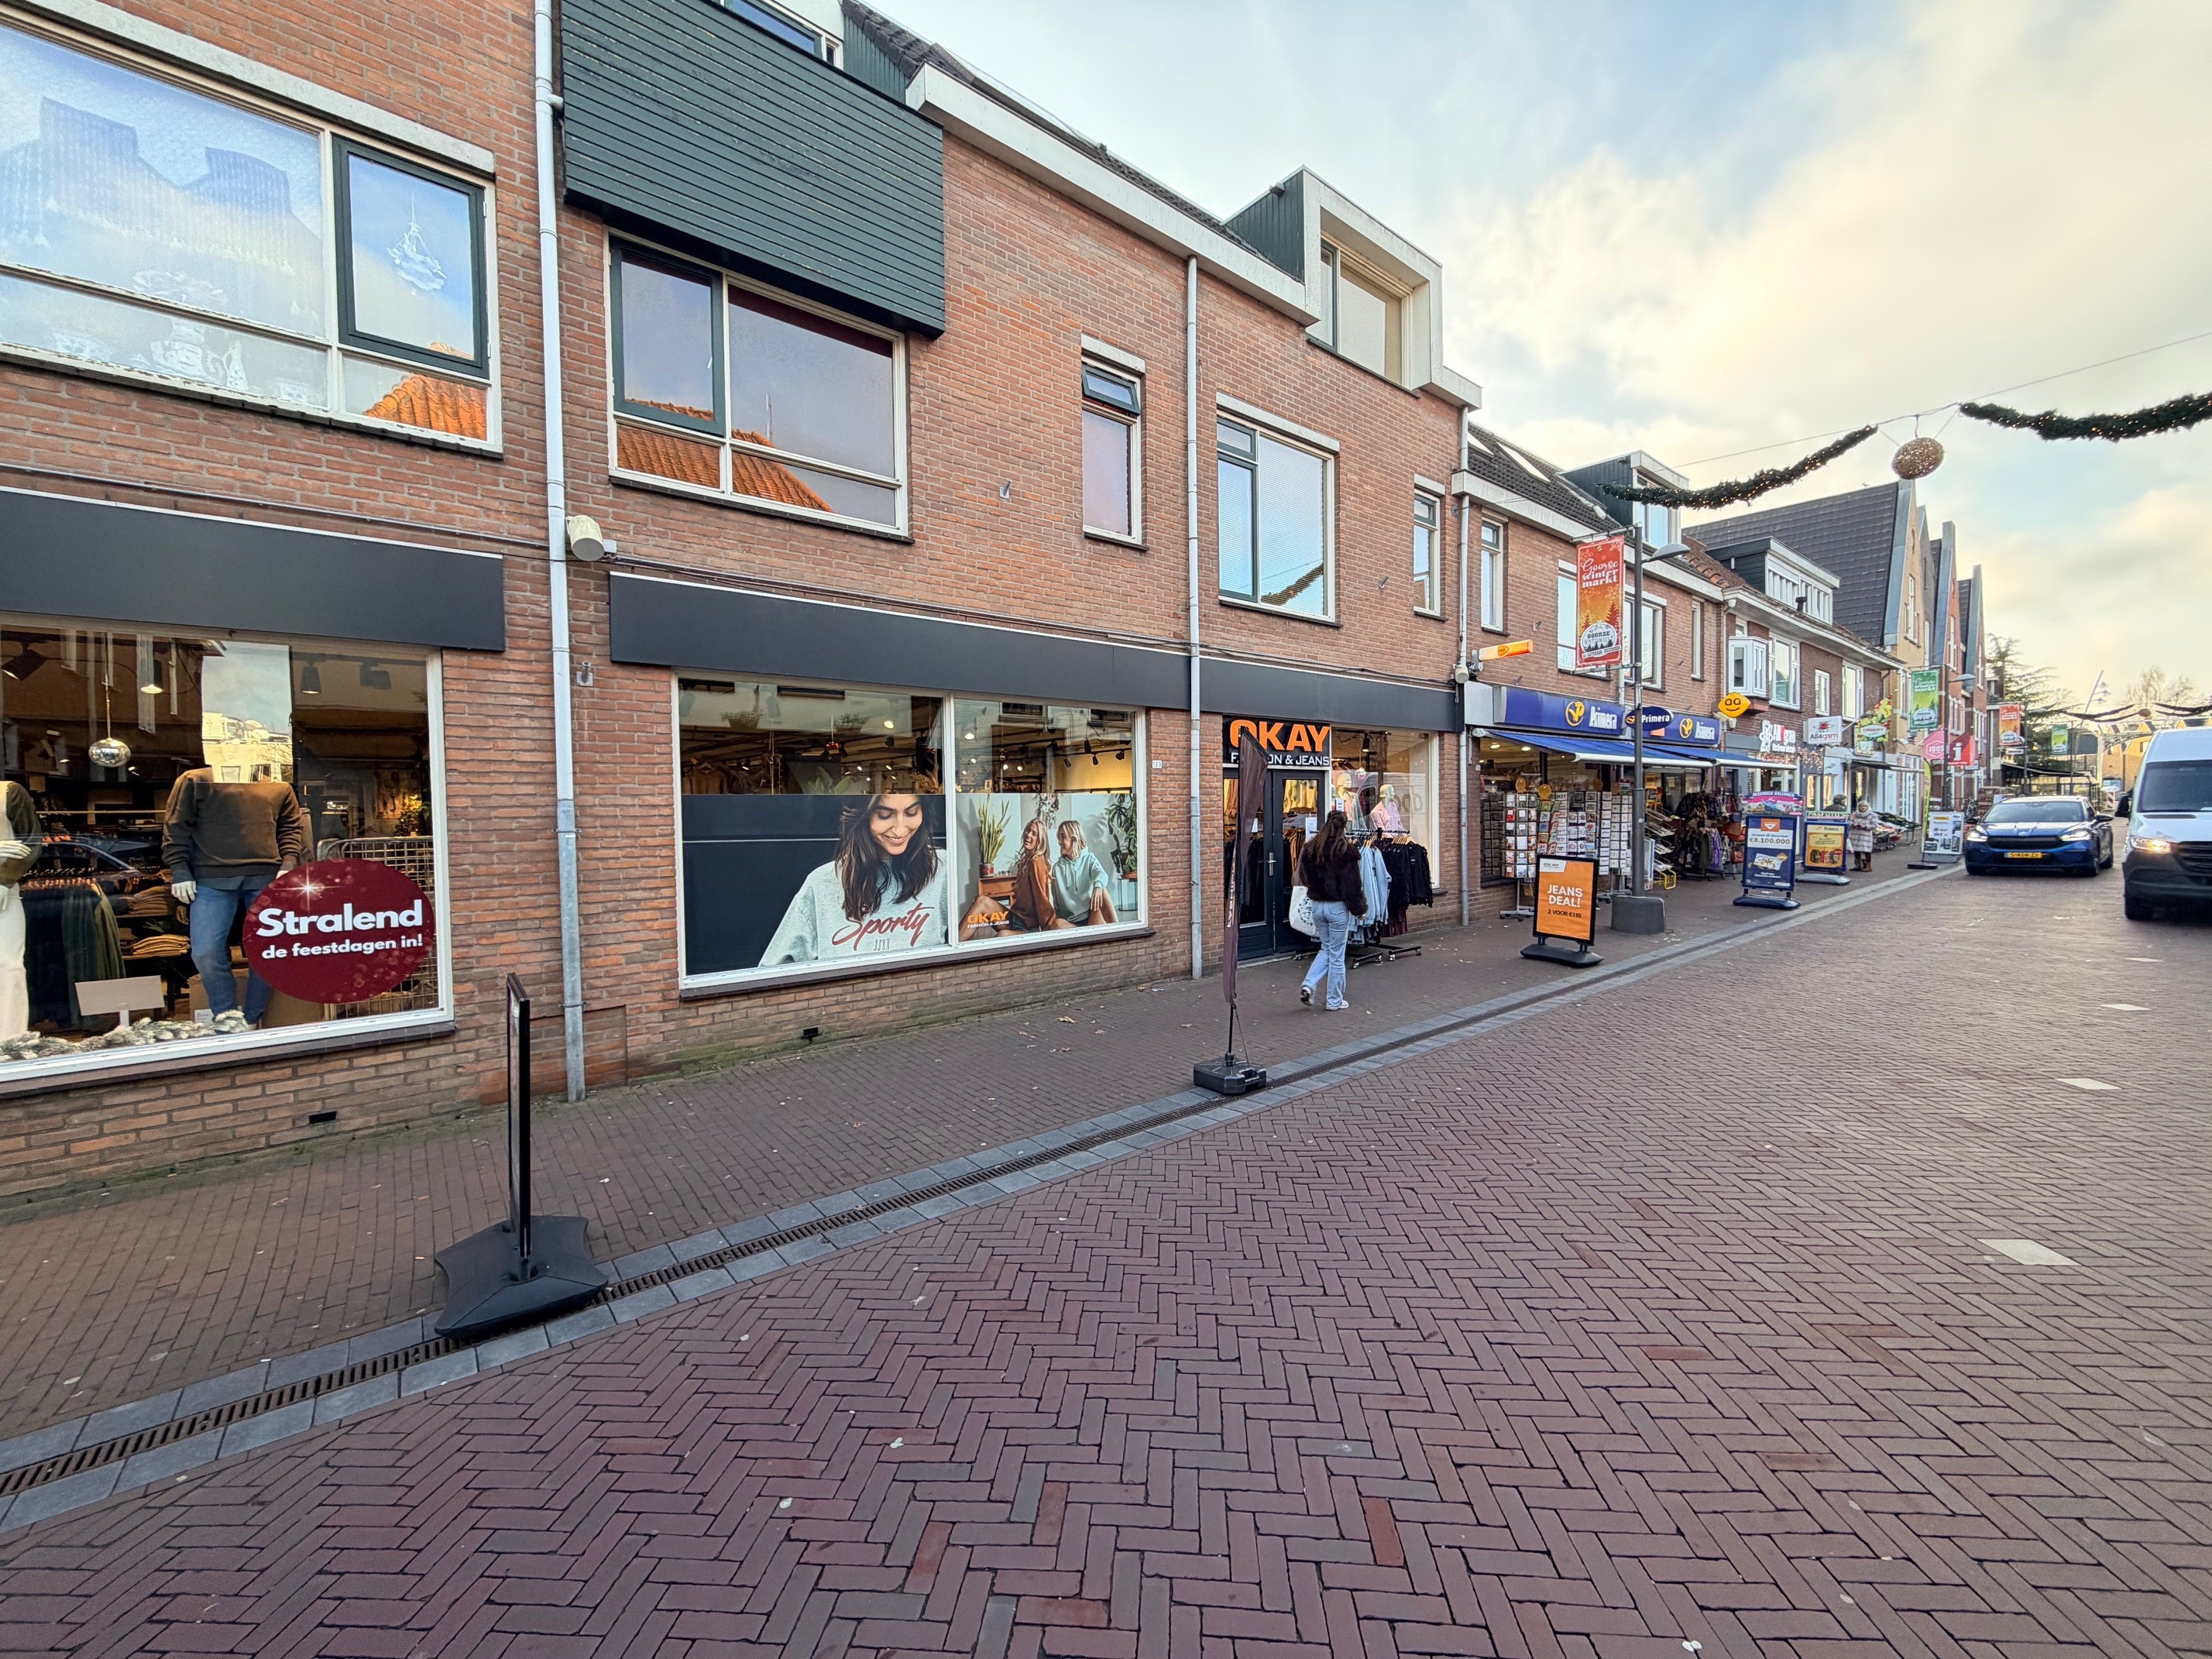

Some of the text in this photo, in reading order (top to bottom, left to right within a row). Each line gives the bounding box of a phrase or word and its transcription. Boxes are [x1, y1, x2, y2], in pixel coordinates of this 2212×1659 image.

[1581, 558, 1619, 575] Goorse
[1582, 568, 1618, 581] winter
[1582, 575, 1618, 589] markt
[1589, 706, 1616, 730] Primera
[1641, 714, 1669, 723] Primera
[1230, 720, 1330, 752] OKAY
[1810, 733, 1838, 741] All4gsm
[1286, 754, 1293, 764] &
[1296, 755, 1330, 766] JEANS
[1547, 884, 1583, 898] JEANS
[1548, 895, 1581, 908] DEAL!
[256, 899, 423, 937] Stralend
[967, 911, 1009, 924] OKAY
[832, 902, 935, 951] Sporty
[261, 937, 423, 960] de feestdagen in!
